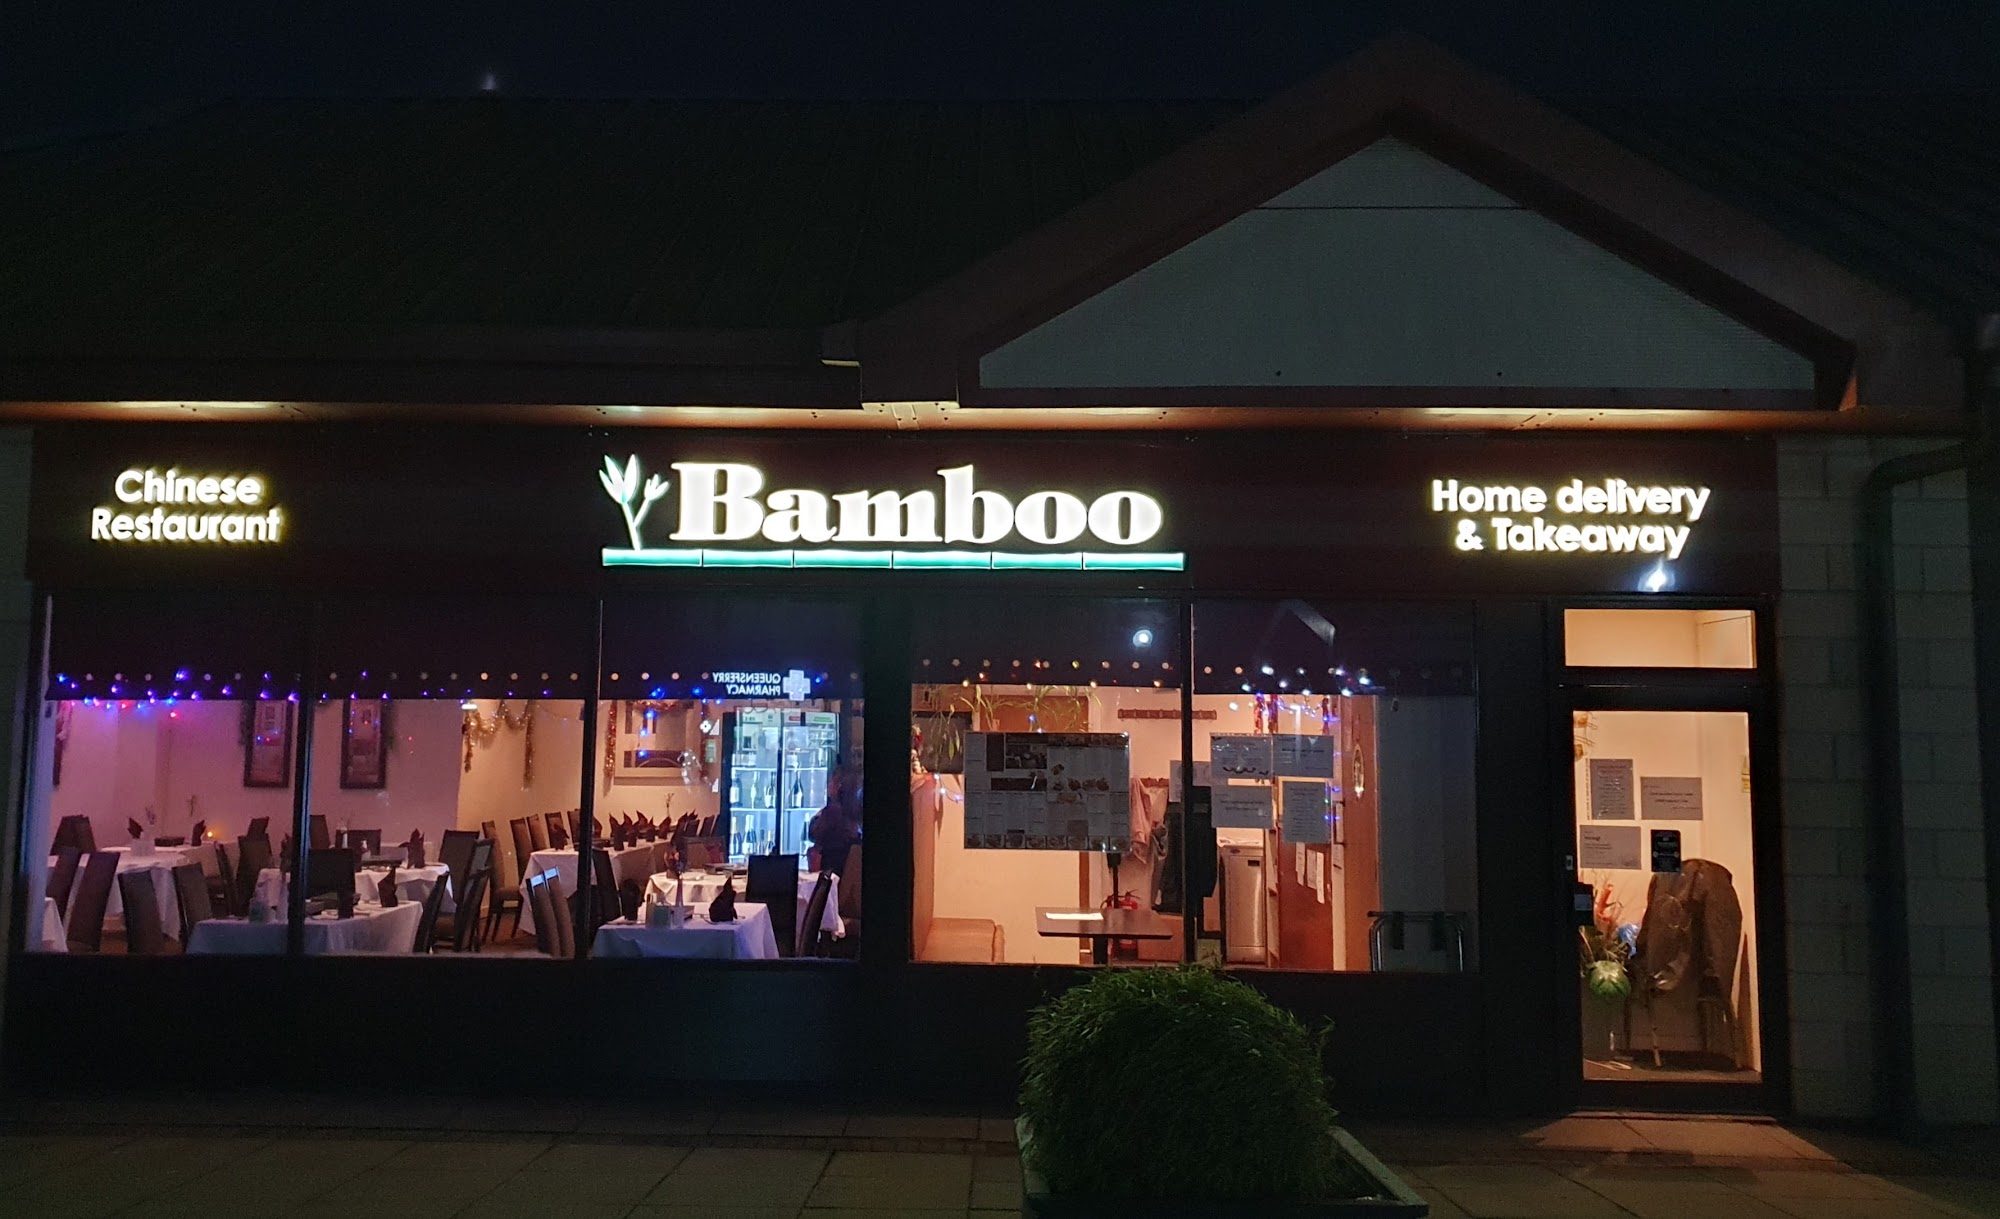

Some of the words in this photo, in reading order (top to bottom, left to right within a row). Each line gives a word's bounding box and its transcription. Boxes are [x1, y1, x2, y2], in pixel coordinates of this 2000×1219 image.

[114, 470, 264, 503] Chinese
[670, 461, 1163, 545] Bamboo
[1431, 478, 1547, 512] Home
[1555, 478, 1711, 521] delivery
[91, 507, 282, 542] Restaurant
[1455, 519, 1484, 551] &
[1491, 517, 1690, 559] Takeaway
